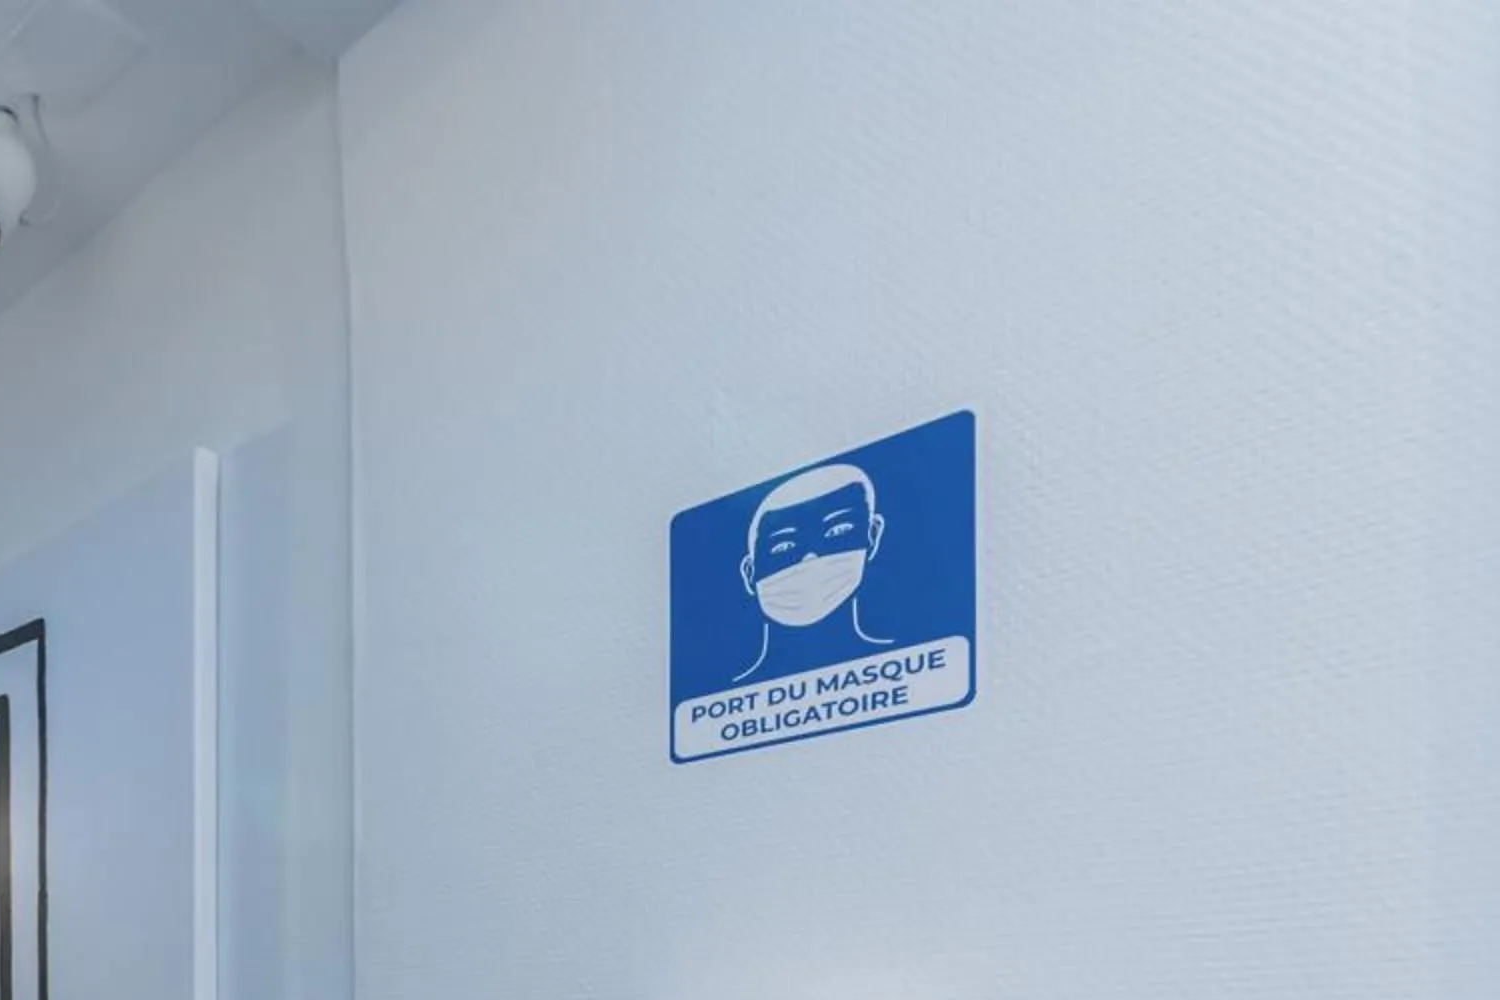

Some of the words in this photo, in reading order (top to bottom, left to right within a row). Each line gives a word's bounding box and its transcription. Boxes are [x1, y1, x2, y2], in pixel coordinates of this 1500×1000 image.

[691, 692, 759, 723] PORT
[767, 681, 807, 708] DU
[816, 648, 948, 696] MASQUE
[720, 685, 910, 741] OBLIGATOIRE
